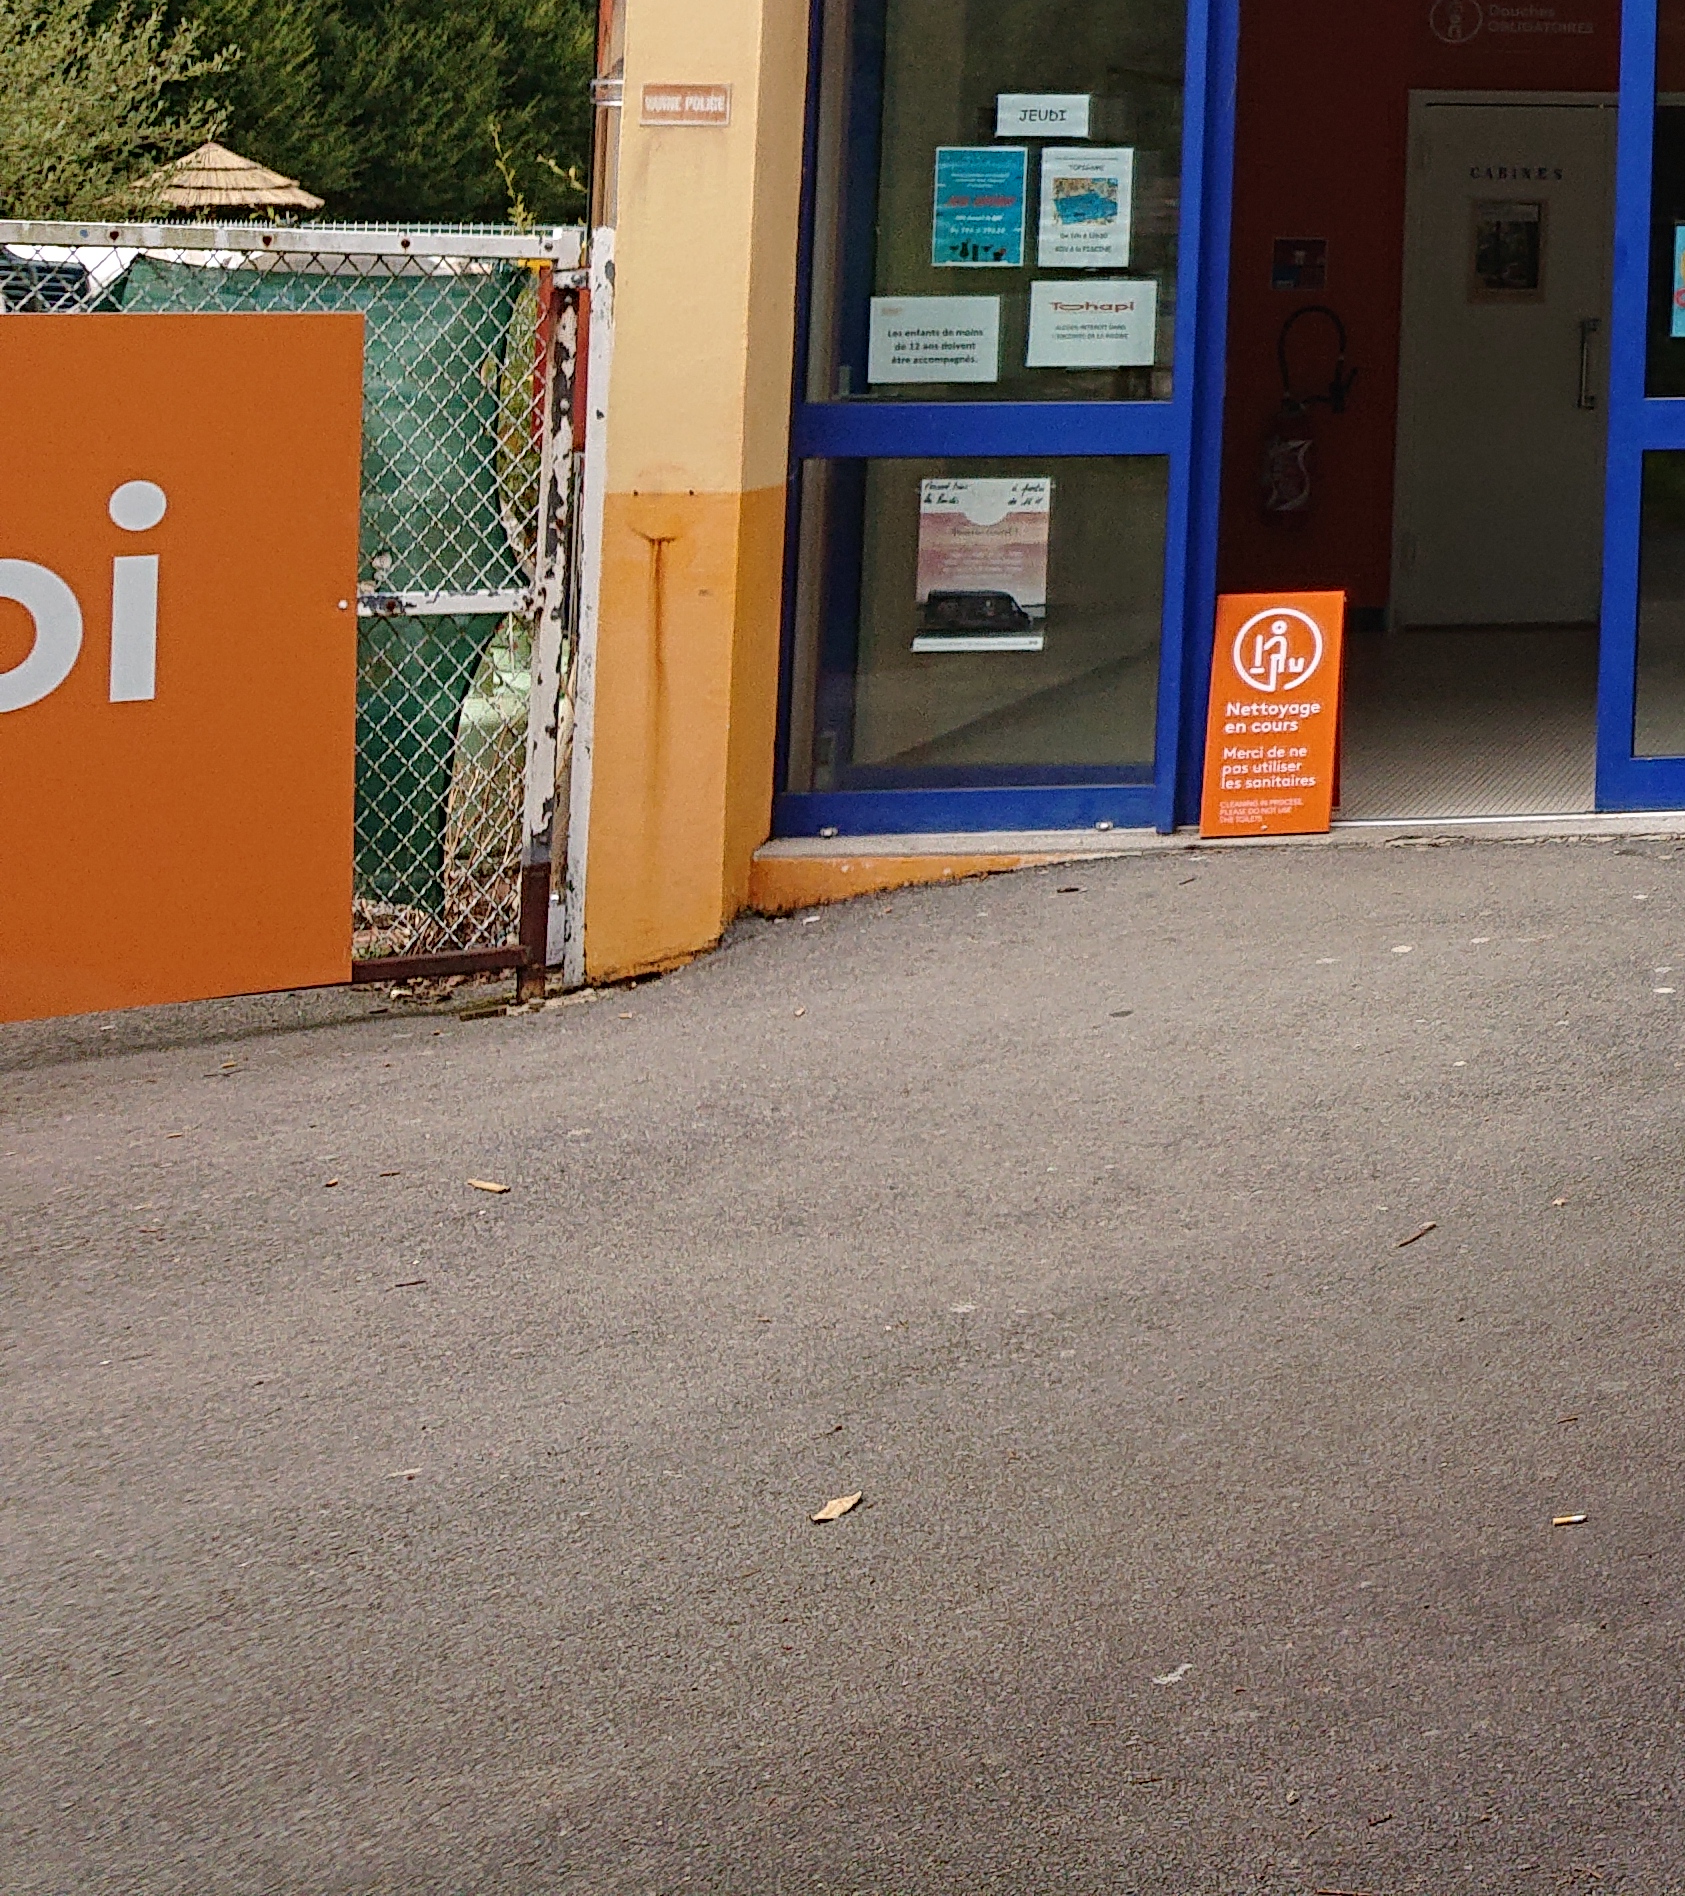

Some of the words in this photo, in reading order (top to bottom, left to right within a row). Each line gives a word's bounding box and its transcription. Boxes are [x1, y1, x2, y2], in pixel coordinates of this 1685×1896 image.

[1018, 109, 1067, 122] JEUDI
[1469, 167, 1564, 181] CABINES
[887, 329, 902, 338] Les
[904, 328, 939, 338] enfants
[941, 328, 954, 338] de
[955, 328, 983, 338] moins
[894, 341, 906, 352] de
[909, 342, 920, 352] 12
[922, 343, 938, 351] ans
[941, 340, 977, 351] doivent
[891, 355, 911, 364] être
[912, 354, 979, 366] accompagnés.
[1225, 701, 1321, 719] Nettoyage
[1224, 722, 1247, 734] en
[1251, 720, 1299, 733] cours
[1223, 746, 1264, 760] Merci
[1266, 746, 1286, 758] de
[1289, 746, 1308, 757] ne
[1222, 764, 1249, 778] pas
[1252, 760, 1303, 774] utiliser
[1220, 776, 1242, 790] les
[1244, 774, 1317, 789] sanitaires
